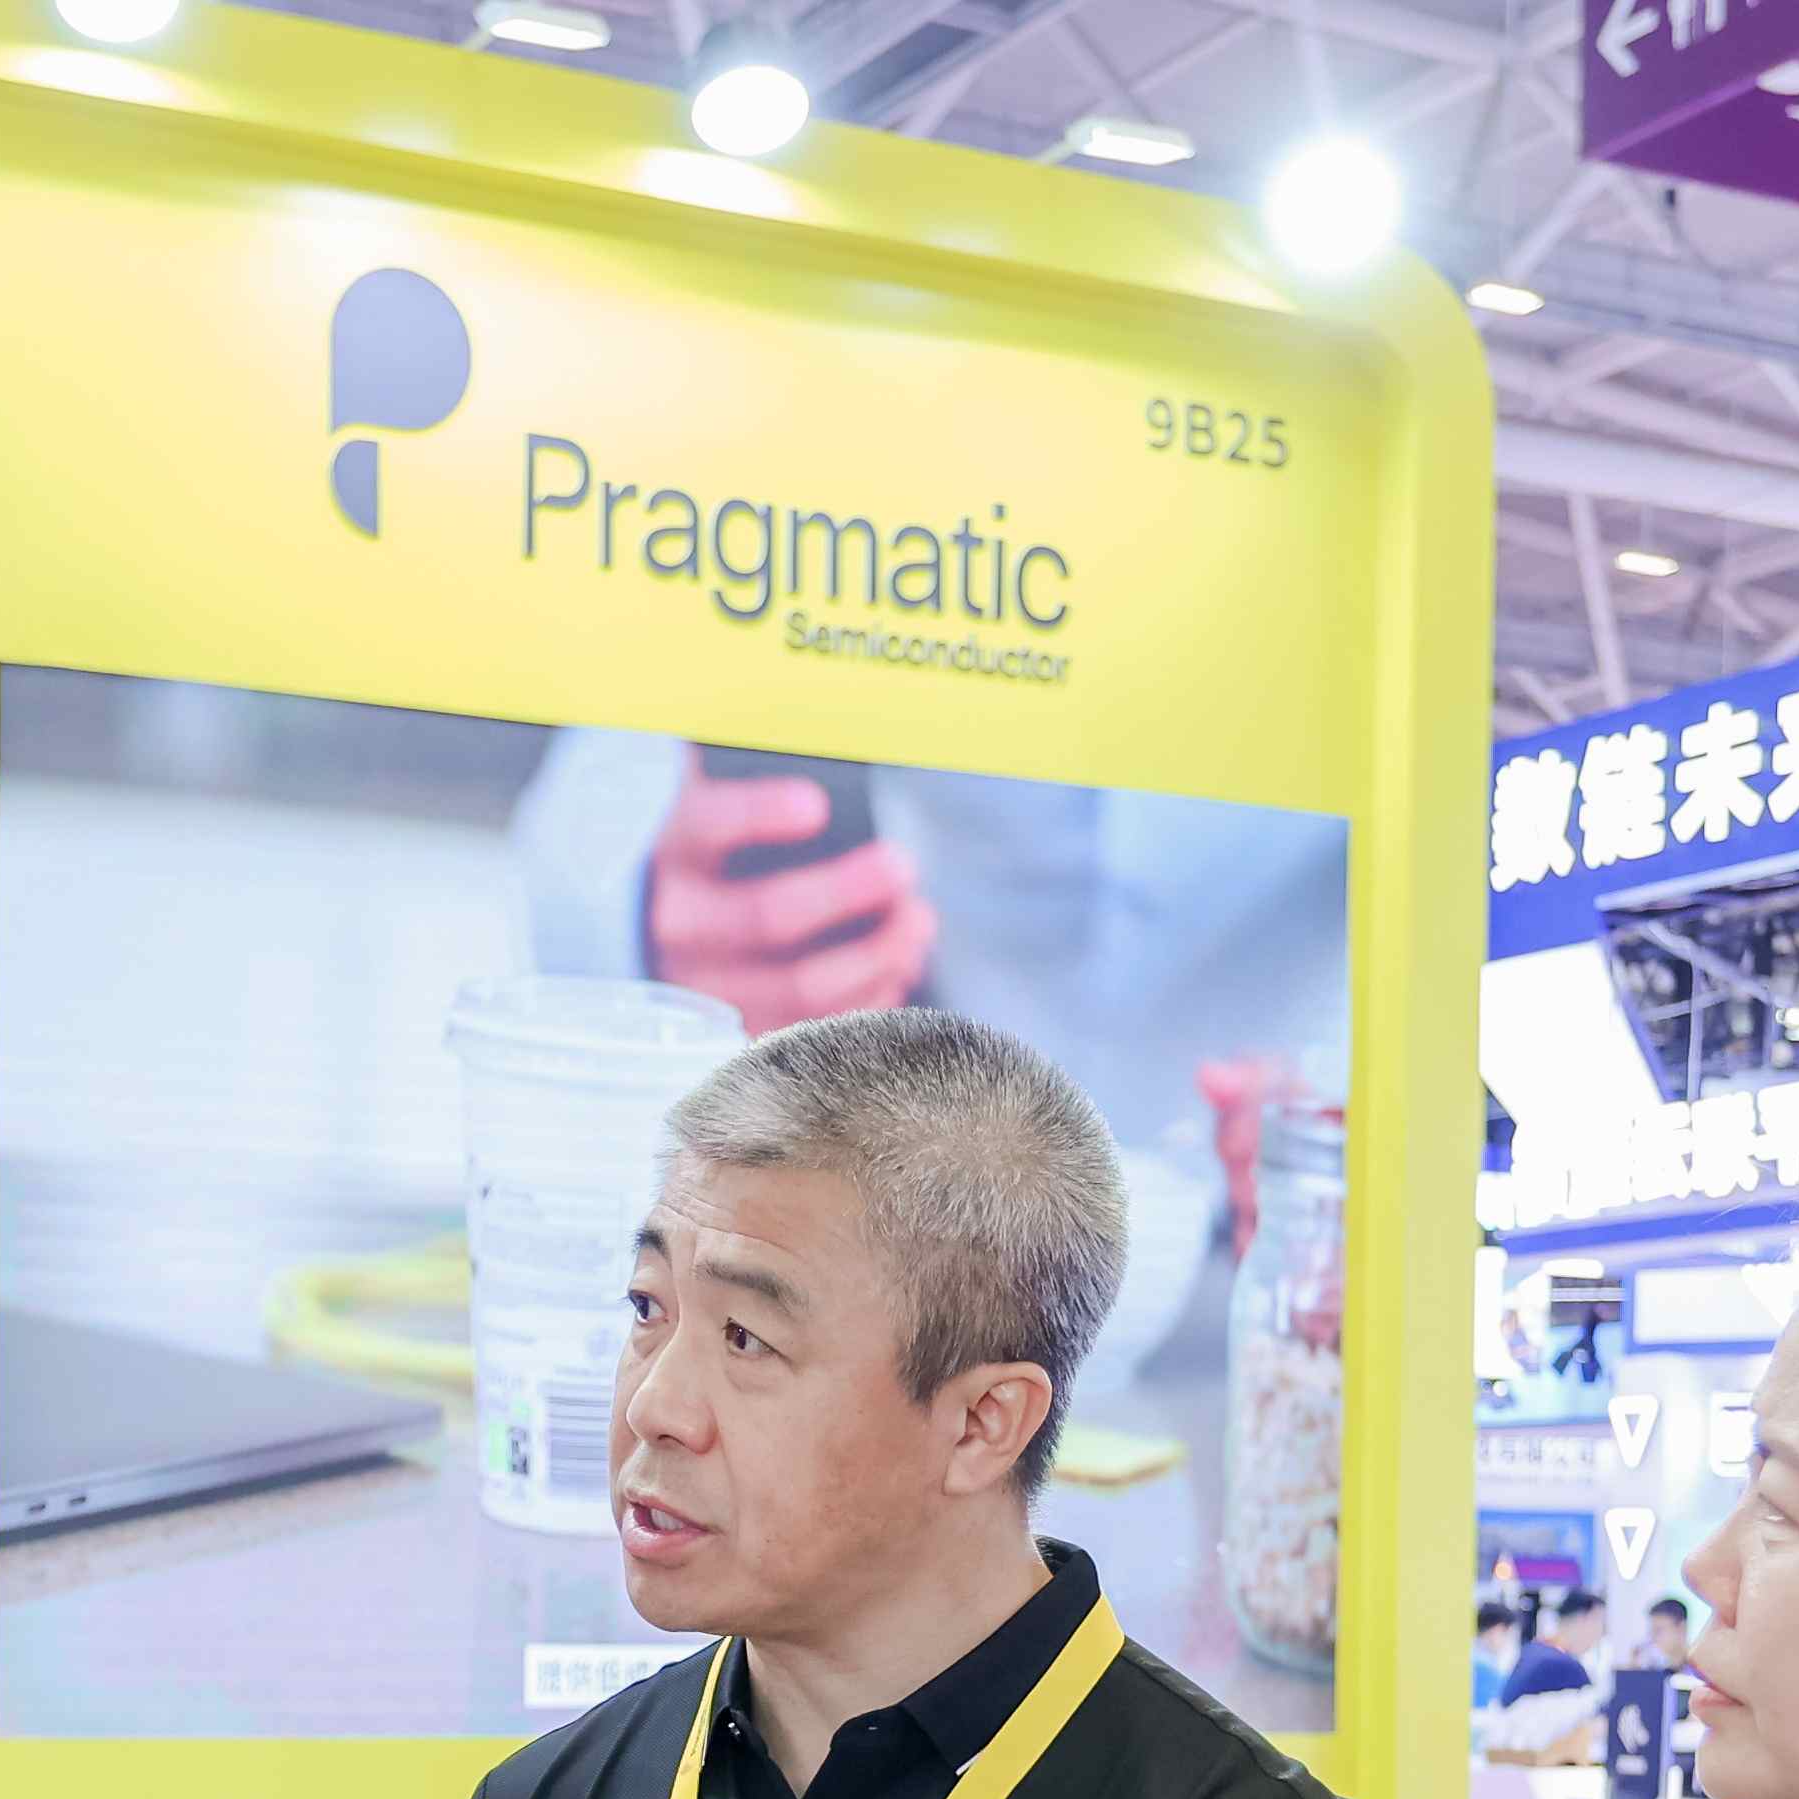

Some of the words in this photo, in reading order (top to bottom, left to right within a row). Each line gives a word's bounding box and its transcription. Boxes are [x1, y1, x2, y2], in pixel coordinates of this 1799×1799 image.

[1145, 398, 1292, 470] 9B25
[523, 432, 1070, 630] Pragmatic
[786, 610, 1070, 684] Semiconductor
